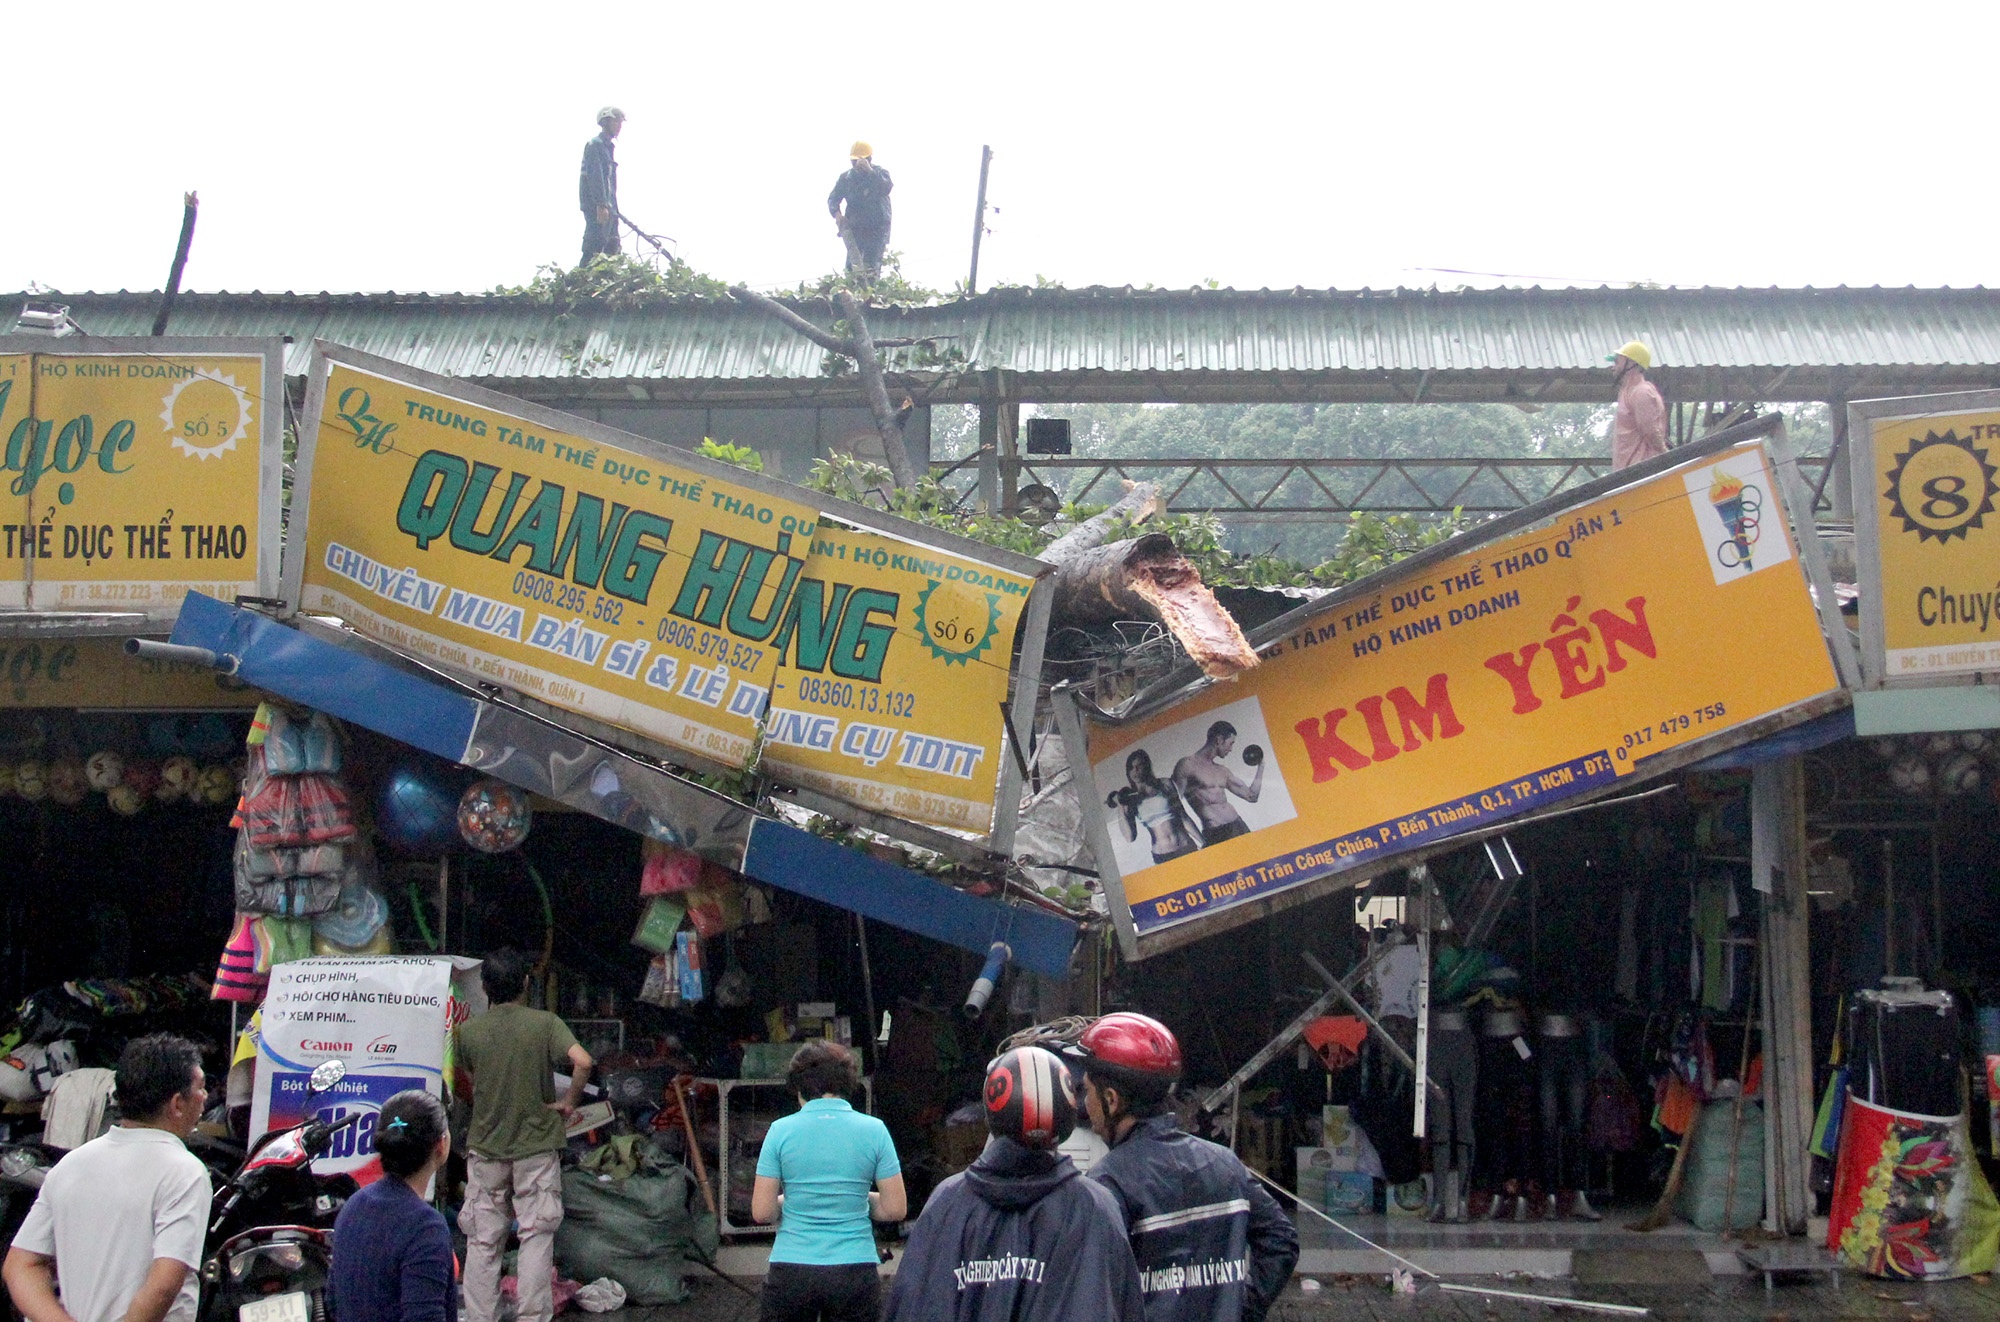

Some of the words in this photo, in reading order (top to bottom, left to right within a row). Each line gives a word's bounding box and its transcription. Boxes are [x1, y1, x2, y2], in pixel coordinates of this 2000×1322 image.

[40, 360, 67, 379] HỘ
[75, 364, 120, 378] KINH
[127, 364, 196, 380] DOANH
[184, 413, 209, 437] SỐ
[217, 421, 229, 437] 5
[404, 400, 488, 437] TRUNG
[497, 426, 546, 454] TÂM
[554, 443, 600, 470] THỂ
[602, 459, 651, 485] DỤC
[657, 475, 707, 503] THỂ
[711, 491, 774, 525] THAO
[854, 545, 889, 572] HỘ
[891, 556, 945, 577] KINH
[946, 566, 1031, 598] DOANH
[1920, 476, 1970, 520] 8
[3, 506, 55, 560] THỂ
[64, 525, 114, 567] DỤC
[124, 508, 174, 560] THỂ
[181, 525, 248, 560] THAO
[396, 449, 675, 607] QUANG
[1288, 623, 1337, 649] TÂM
[1341, 594, 1383, 632] THỂ
[1390, 586, 1436, 615] DỤC
[1440, 559, 1485, 597] THỂ
[1490, 547, 1549, 578] THAO
[1611, 508, 1623, 527] 1
[933, 616, 958, 642] SỐ
[963, 627, 976, 645] 6
[1352, 631, 1383, 658] HỘ
[1390, 614, 1441, 645] KINH
[1448, 589, 1522, 627] DOANH
[325, 542, 445, 614] CHUYÊN
[440, 588, 525, 642] MUA
[529, 614, 608, 666] BÁN
[604, 640, 651, 679] SỈ
[683, 663, 729, 707] LẺ
[840, 721, 896, 767] CỤ
[897, 733, 985, 779] TDTT
[512, 571, 625, 627] 0908.295.562
[657, 616, 764, 674] 0906.979.527
[799, 676, 916, 718] 08360.13.132
[1295, 672, 1466, 783] KIM
[1484, 594, 1658, 717] YẾN
[1155, 895, 1185, 918] ĐC:
[1185, 890, 1208, 908] 01
[1257, 860, 1294, 884] Trân
[1295, 848, 1336, 872] Công
[1335, 834, 1380, 859] Chúa,
[1398, 814, 1429, 838] Bến
[1428, 799, 1480, 828] Thành,
[1480, 790, 1513, 811] Q.1,
[1511, 782, 1539, 801] TP.
[1539, 766, 1574, 795] HCM
[1585, 755, 1611, 777] ĐT:
[1659, 714, 1691, 737] 479
[1694, 701, 1727, 725] 758
[296, 973, 326, 986] CHỤP
[328, 970, 360, 984] HÌNH,
[315, 991, 340, 1005] CHỢ
[342, 990, 376, 1004] HÀNG
[378, 992, 402, 1005] TIÊU
[404, 993, 442, 1008] DÙNG,
[289, 1011, 314, 1022] XEM
[316, 1012, 357, 1024] PHIM...
[300, 1039, 353, 1051] Canon
[281, 1080, 303, 1097] Bột
[335, 1081, 368, 1096] Nhiệt
[1036, 1261, 1045, 1284] 1
[1203, 1257, 1215, 1286] LÝ
